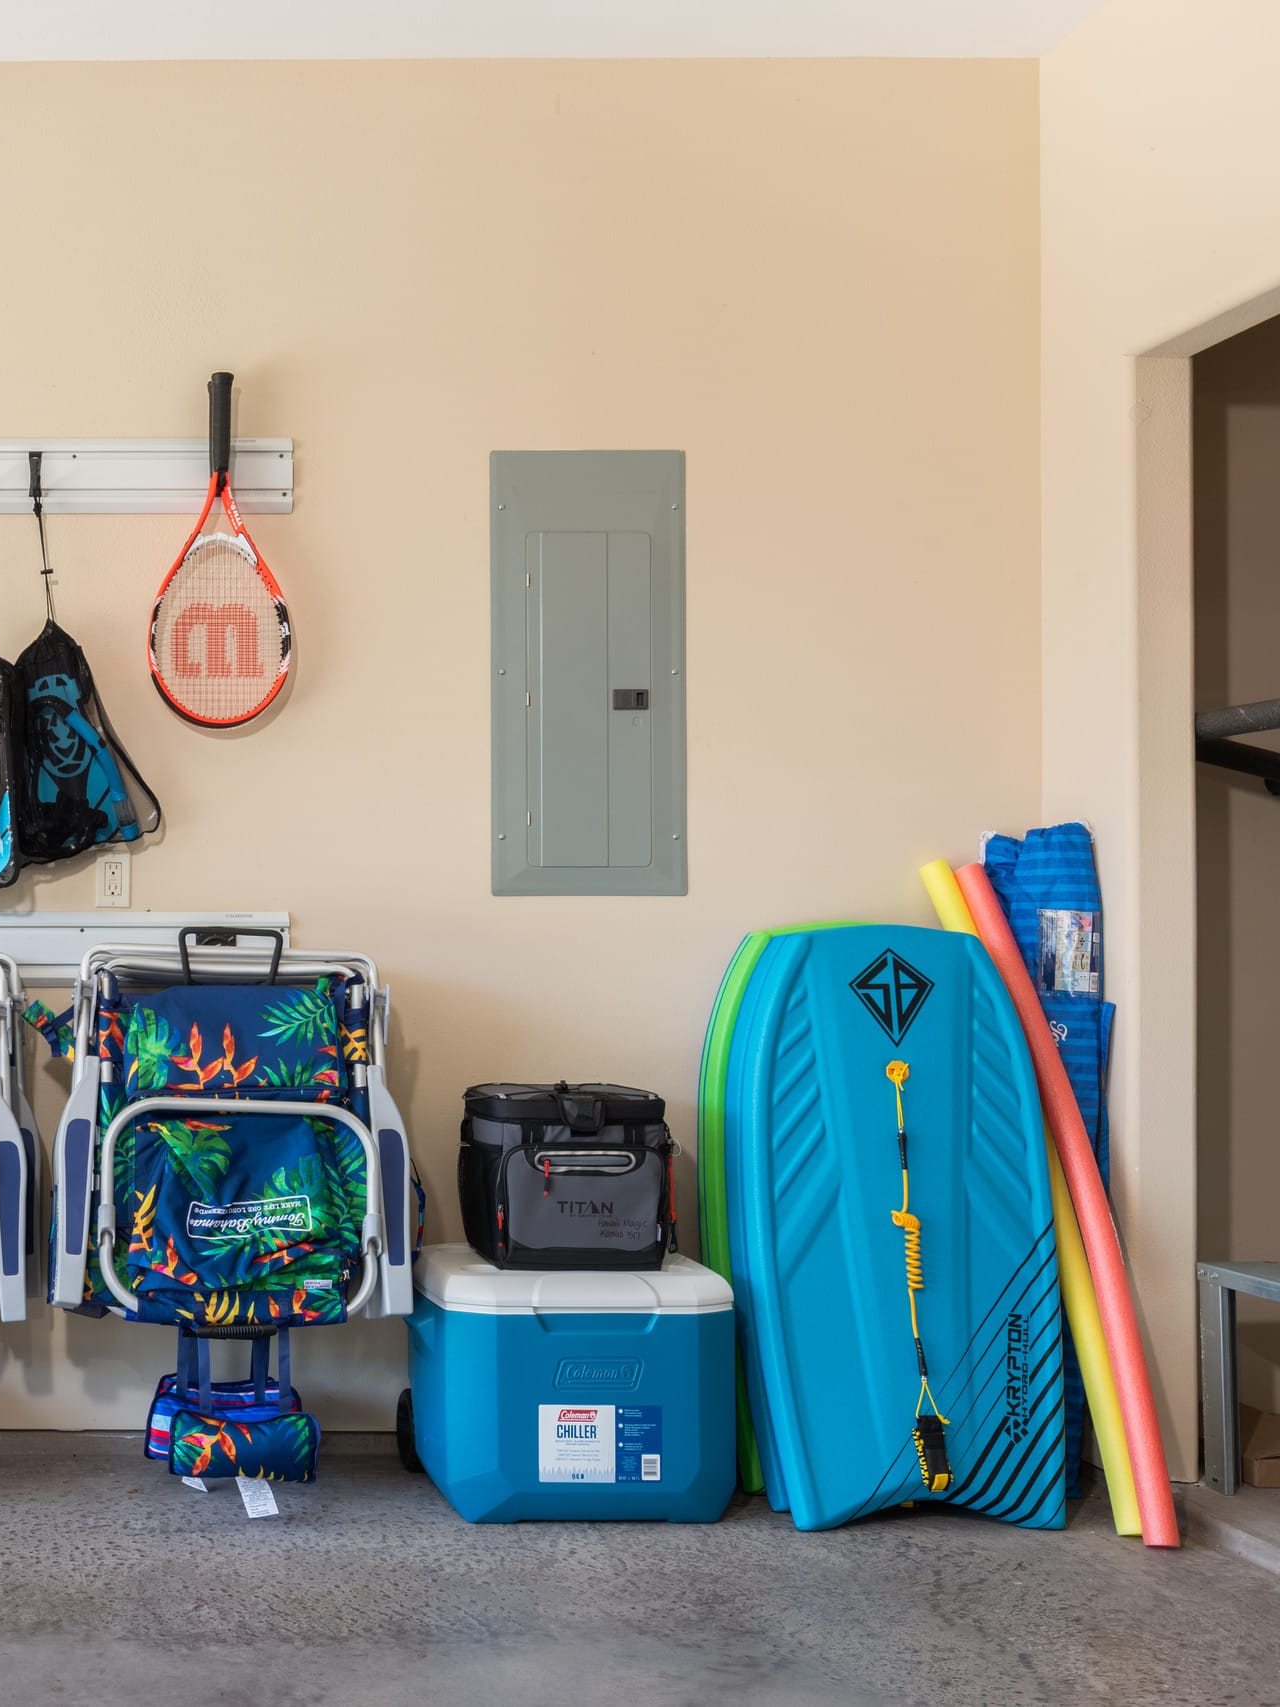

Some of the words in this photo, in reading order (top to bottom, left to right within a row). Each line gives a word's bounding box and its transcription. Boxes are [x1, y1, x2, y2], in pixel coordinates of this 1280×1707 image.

[280, 1201, 302, 1209] MAKE
[557, 1200, 614, 1214] TITAN
[193, 1218, 252, 1233] Bahama
[250, 1212, 305, 1228] Tommy
[565, 1363, 619, 1379] Coleman
[1006, 1313, 1022, 1417] KRYPTON
[560, 1410, 590, 1419] Coleman
[556, 1424, 597, 1439] CHILLER
